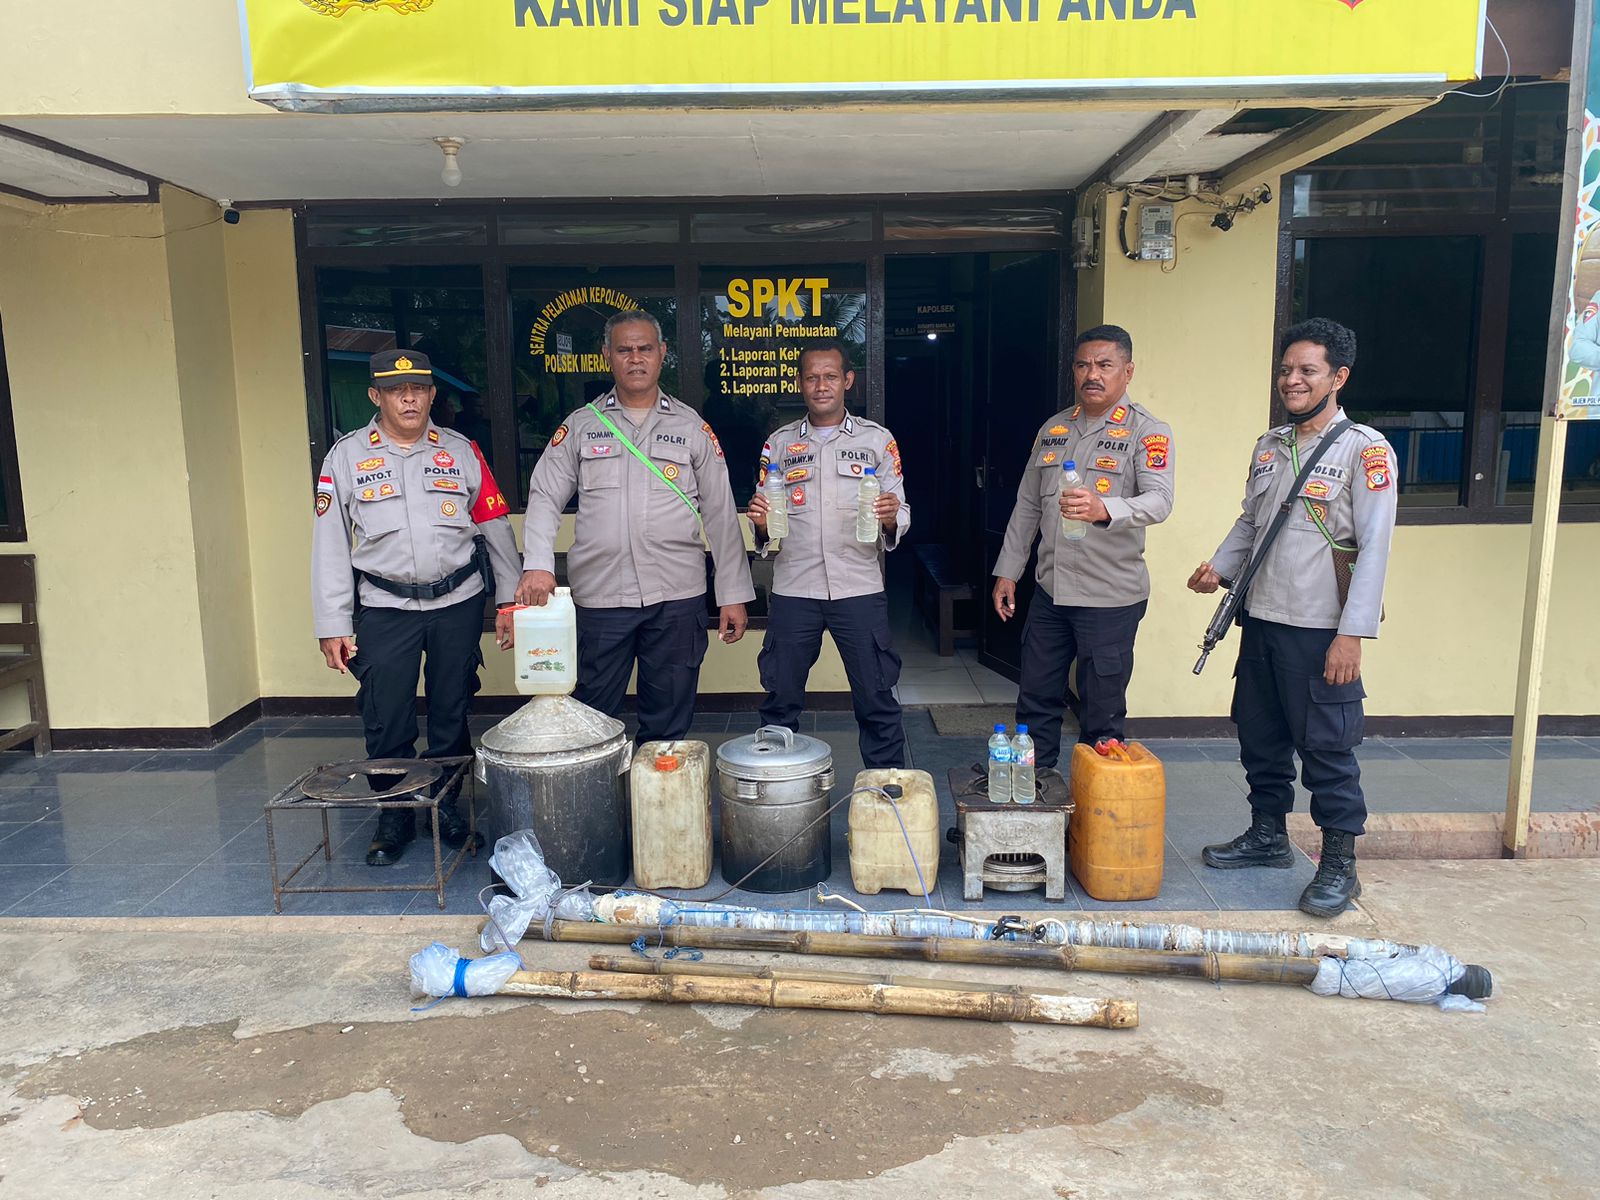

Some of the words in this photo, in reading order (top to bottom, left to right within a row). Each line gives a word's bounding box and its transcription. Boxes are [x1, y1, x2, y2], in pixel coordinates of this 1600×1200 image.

[514, 0, 640, 27] KAMI
[658, 0, 770, 27] SIAP
[790, 0, 1039, 24] MELAYANI
[1057, 0, 1197, 21] ANDA
[727, 277, 829, 318] SPKT
[917, 304, 955, 314] KAPOLSEK
[529, 317, 551, 356] SENTRA
[541, 287, 588, 322] PELAYANAN
[723, 323, 773, 341] Melayani
[775, 323, 838, 338] Pembuatan
[544, 353, 579, 373] POLSEK
[719, 347, 730, 361] 1.
[731, 347, 776, 364] Laporan
[779, 347, 803, 361] Keh
[719, 363, 731, 377] 2.
[732, 363, 777, 380] Laporan
[720, 380, 731, 394] 3.
[732, 380, 777, 397] Laporan
[656, 434, 686, 445] POLRI
[1096, 440, 1129, 452] POLRI
[841, 450, 869, 461] POLRI
[356, 470, 392, 485] MATO.T
[424, 467, 460, 476] POLRI
[1314, 464, 1343, 479] OLRI
